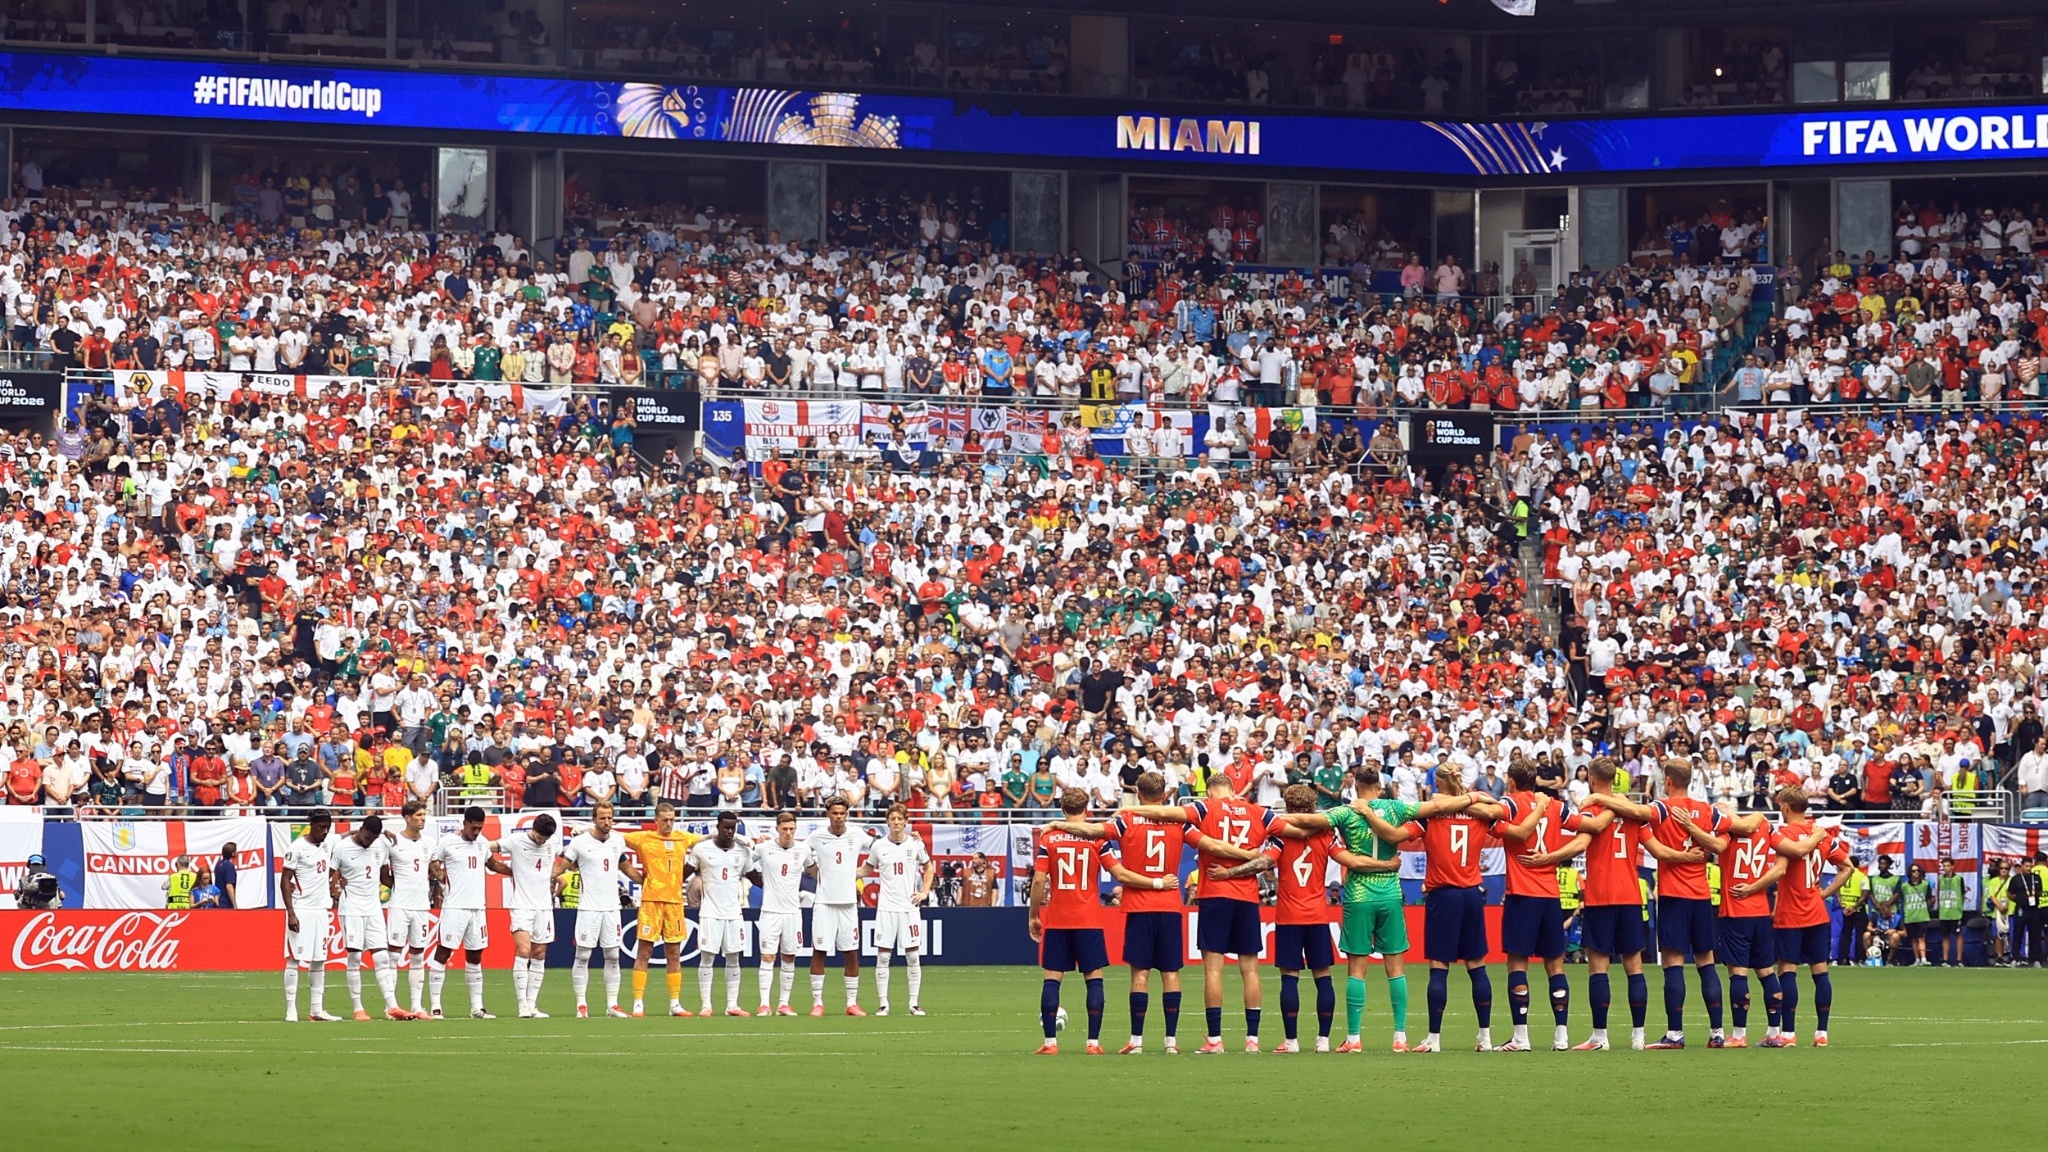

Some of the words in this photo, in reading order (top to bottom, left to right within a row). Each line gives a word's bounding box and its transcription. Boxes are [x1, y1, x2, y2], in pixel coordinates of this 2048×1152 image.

[193, 75, 382, 118] #FIFAWorldCup
[1116, 115, 1260, 155] MIAMI
[1803, 119, 1898, 156] FIFA
[0, 388, 26, 396] ORLD
[12, 398, 46, 406] 2026
[637, 397, 656, 406] FIFA
[637, 406, 668, 415] WORLD
[712, 410, 733, 422] 135
[637, 415, 654, 423] CUP
[655, 415, 685, 424] 2026
[1436, 420, 1454, 428] FIFA
[1436, 428, 1466, 436] WORLD
[1436, 437, 1453, 445] CUP
[1453, 437, 1481, 445] 2026
[1218, 816, 1251, 850] 17
[1612, 817, 1628, 859] 3
[1145, 829, 1166, 873] 5
[1450, 824, 1469, 868] 9
[204, 850, 262, 874] VLA
[413, 858, 420, 872] 5
[467, 856, 477, 870] 10
[535, 858, 542, 872] 4
[603, 858, 610, 872] 9
[668, 859, 672, 871] 1
[835, 851, 842, 865] 3
[1732, 836, 1767, 880] 26
[316, 860, 327, 874] 20
[365, 865, 372, 880] 2
[781, 863, 788, 877] 8
[893, 861, 904, 876] 18
[1056, 847, 1090, 890] 21
[1292, 845, 1314, 888] 6
[721, 867, 728, 881] 6
[421, 925, 428, 938] 5
[616, 924, 622, 937] 9
[739, 927, 745, 941] 6
[797, 931, 803, 944] 8
[853, 927, 859, 941] 3
[908, 924, 919, 938] 18
[11, 911, 191, 970] Coca-Cola
